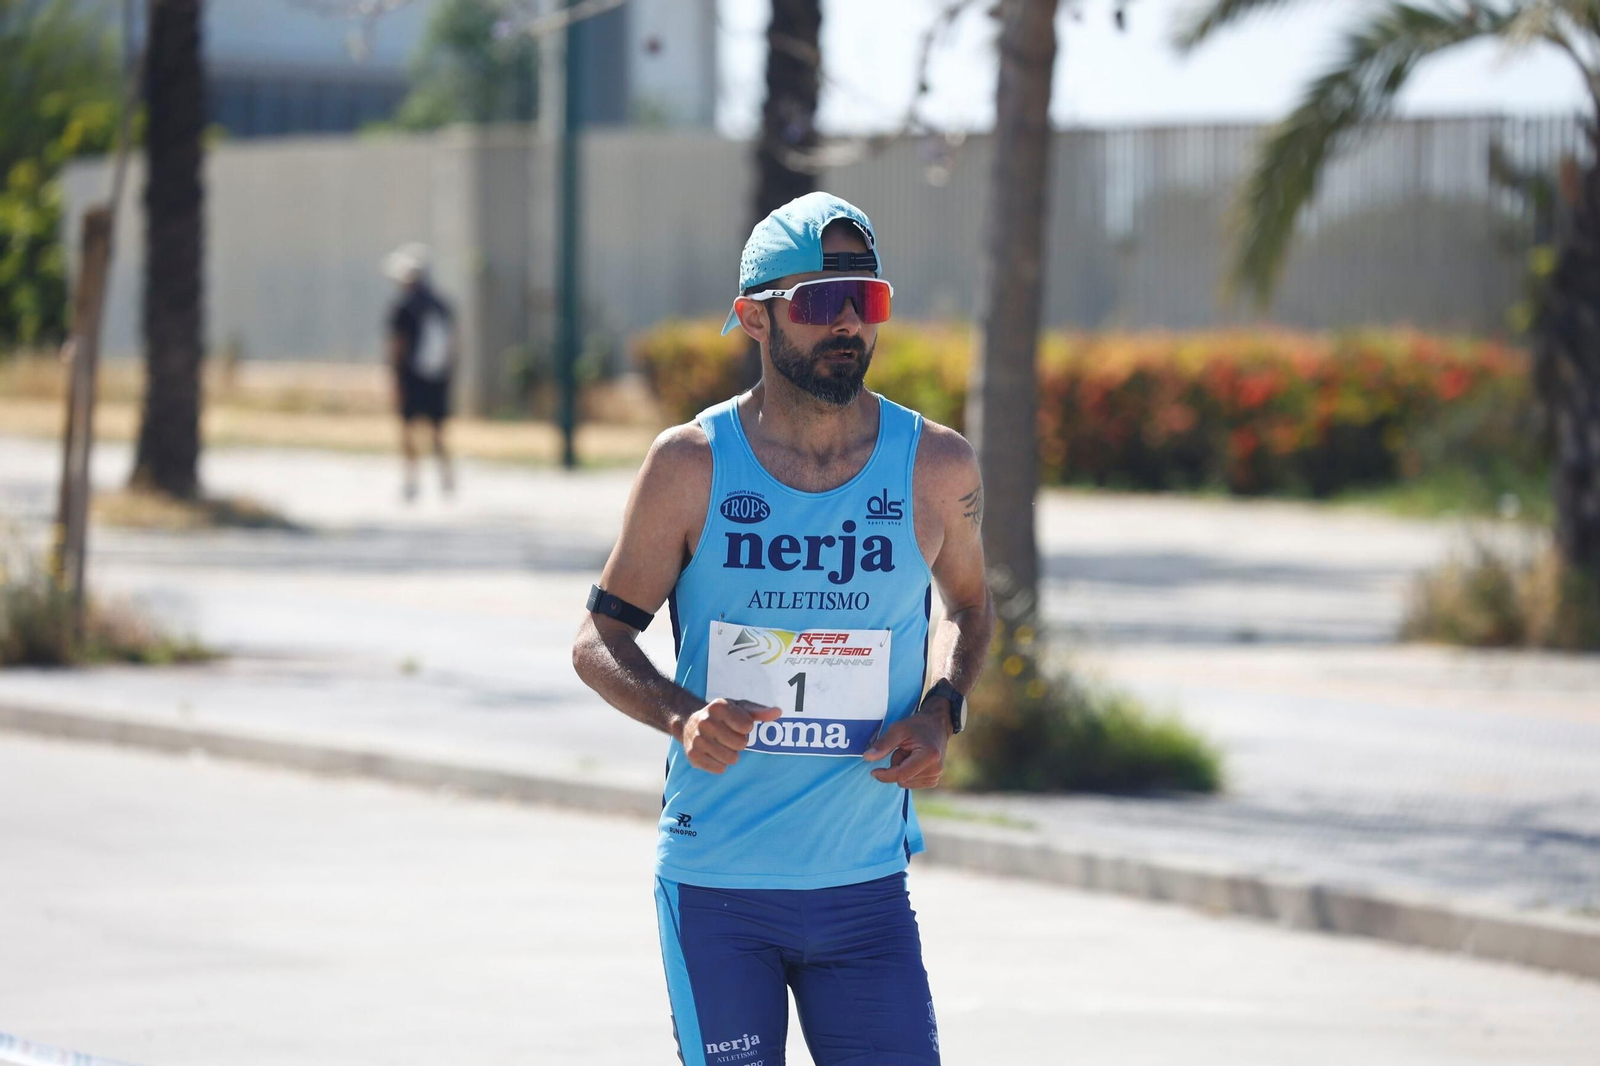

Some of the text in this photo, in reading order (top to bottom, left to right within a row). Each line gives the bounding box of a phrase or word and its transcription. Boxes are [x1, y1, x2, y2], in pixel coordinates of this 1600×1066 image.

[723, 497, 768, 518] TROPS
[866, 488, 903, 520] als
[723, 520, 896, 584] nerja
[747, 589, 870, 610] ATLETISMO
[796, 633, 850, 646] RFEA
[790, 646, 872, 656] ATLETISMO
[784, 657, 874, 667] RUTA RUNNING
[787, 672, 806, 712] 1
[706, 1033, 760, 1054] nerja
[717, 1050, 758, 1063] ATLETISMO
